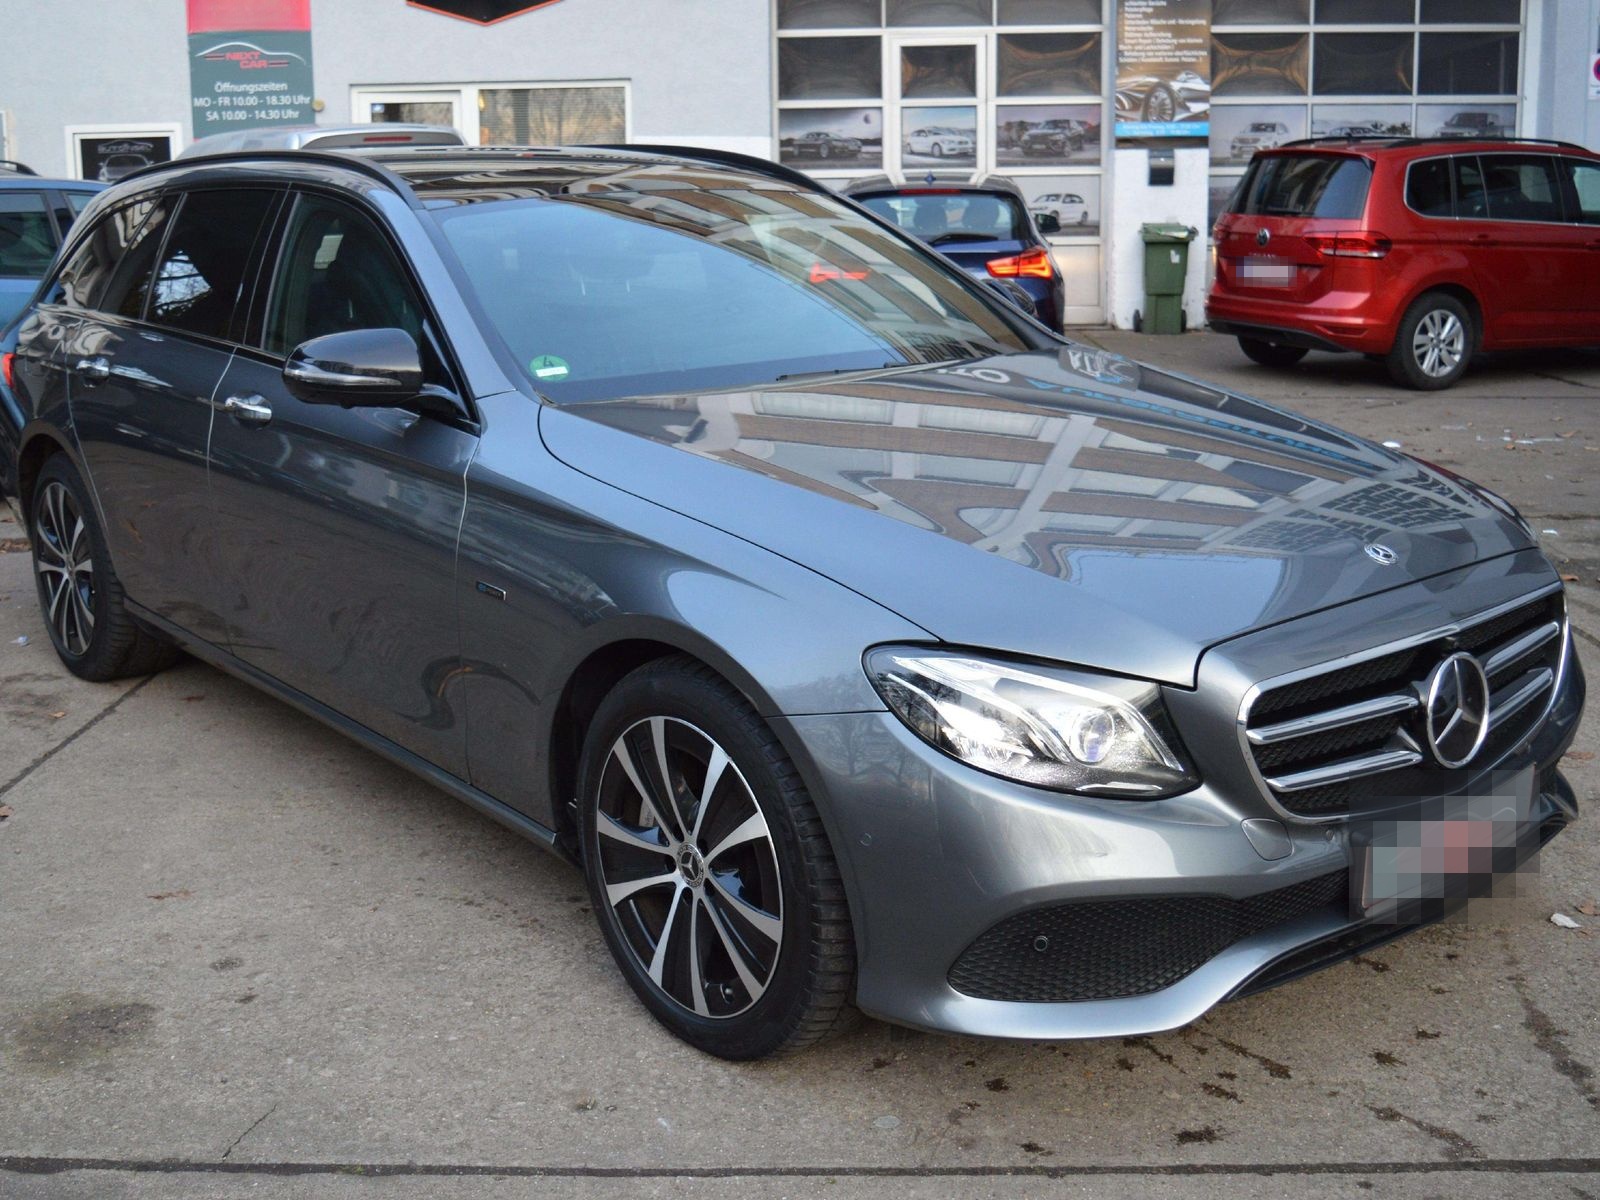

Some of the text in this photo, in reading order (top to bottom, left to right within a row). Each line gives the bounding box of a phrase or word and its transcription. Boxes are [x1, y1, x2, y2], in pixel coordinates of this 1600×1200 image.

[240, 60, 268, 68] CAR
[214, 81, 288, 94] Öffnungszeiten
[193, 97, 211, 107] MO
[218, 96, 231, 106] FR
[233, 96, 258, 106] 10.00
[266, 95, 291, 105] 18.30
[292, 94, 311, 104] Uhr
[205, 111, 219, 121] SA
[222, 110, 247, 120] 10.00
[255, 109, 279, 119] 14.30
[281, 109, 300, 119] Uhr
